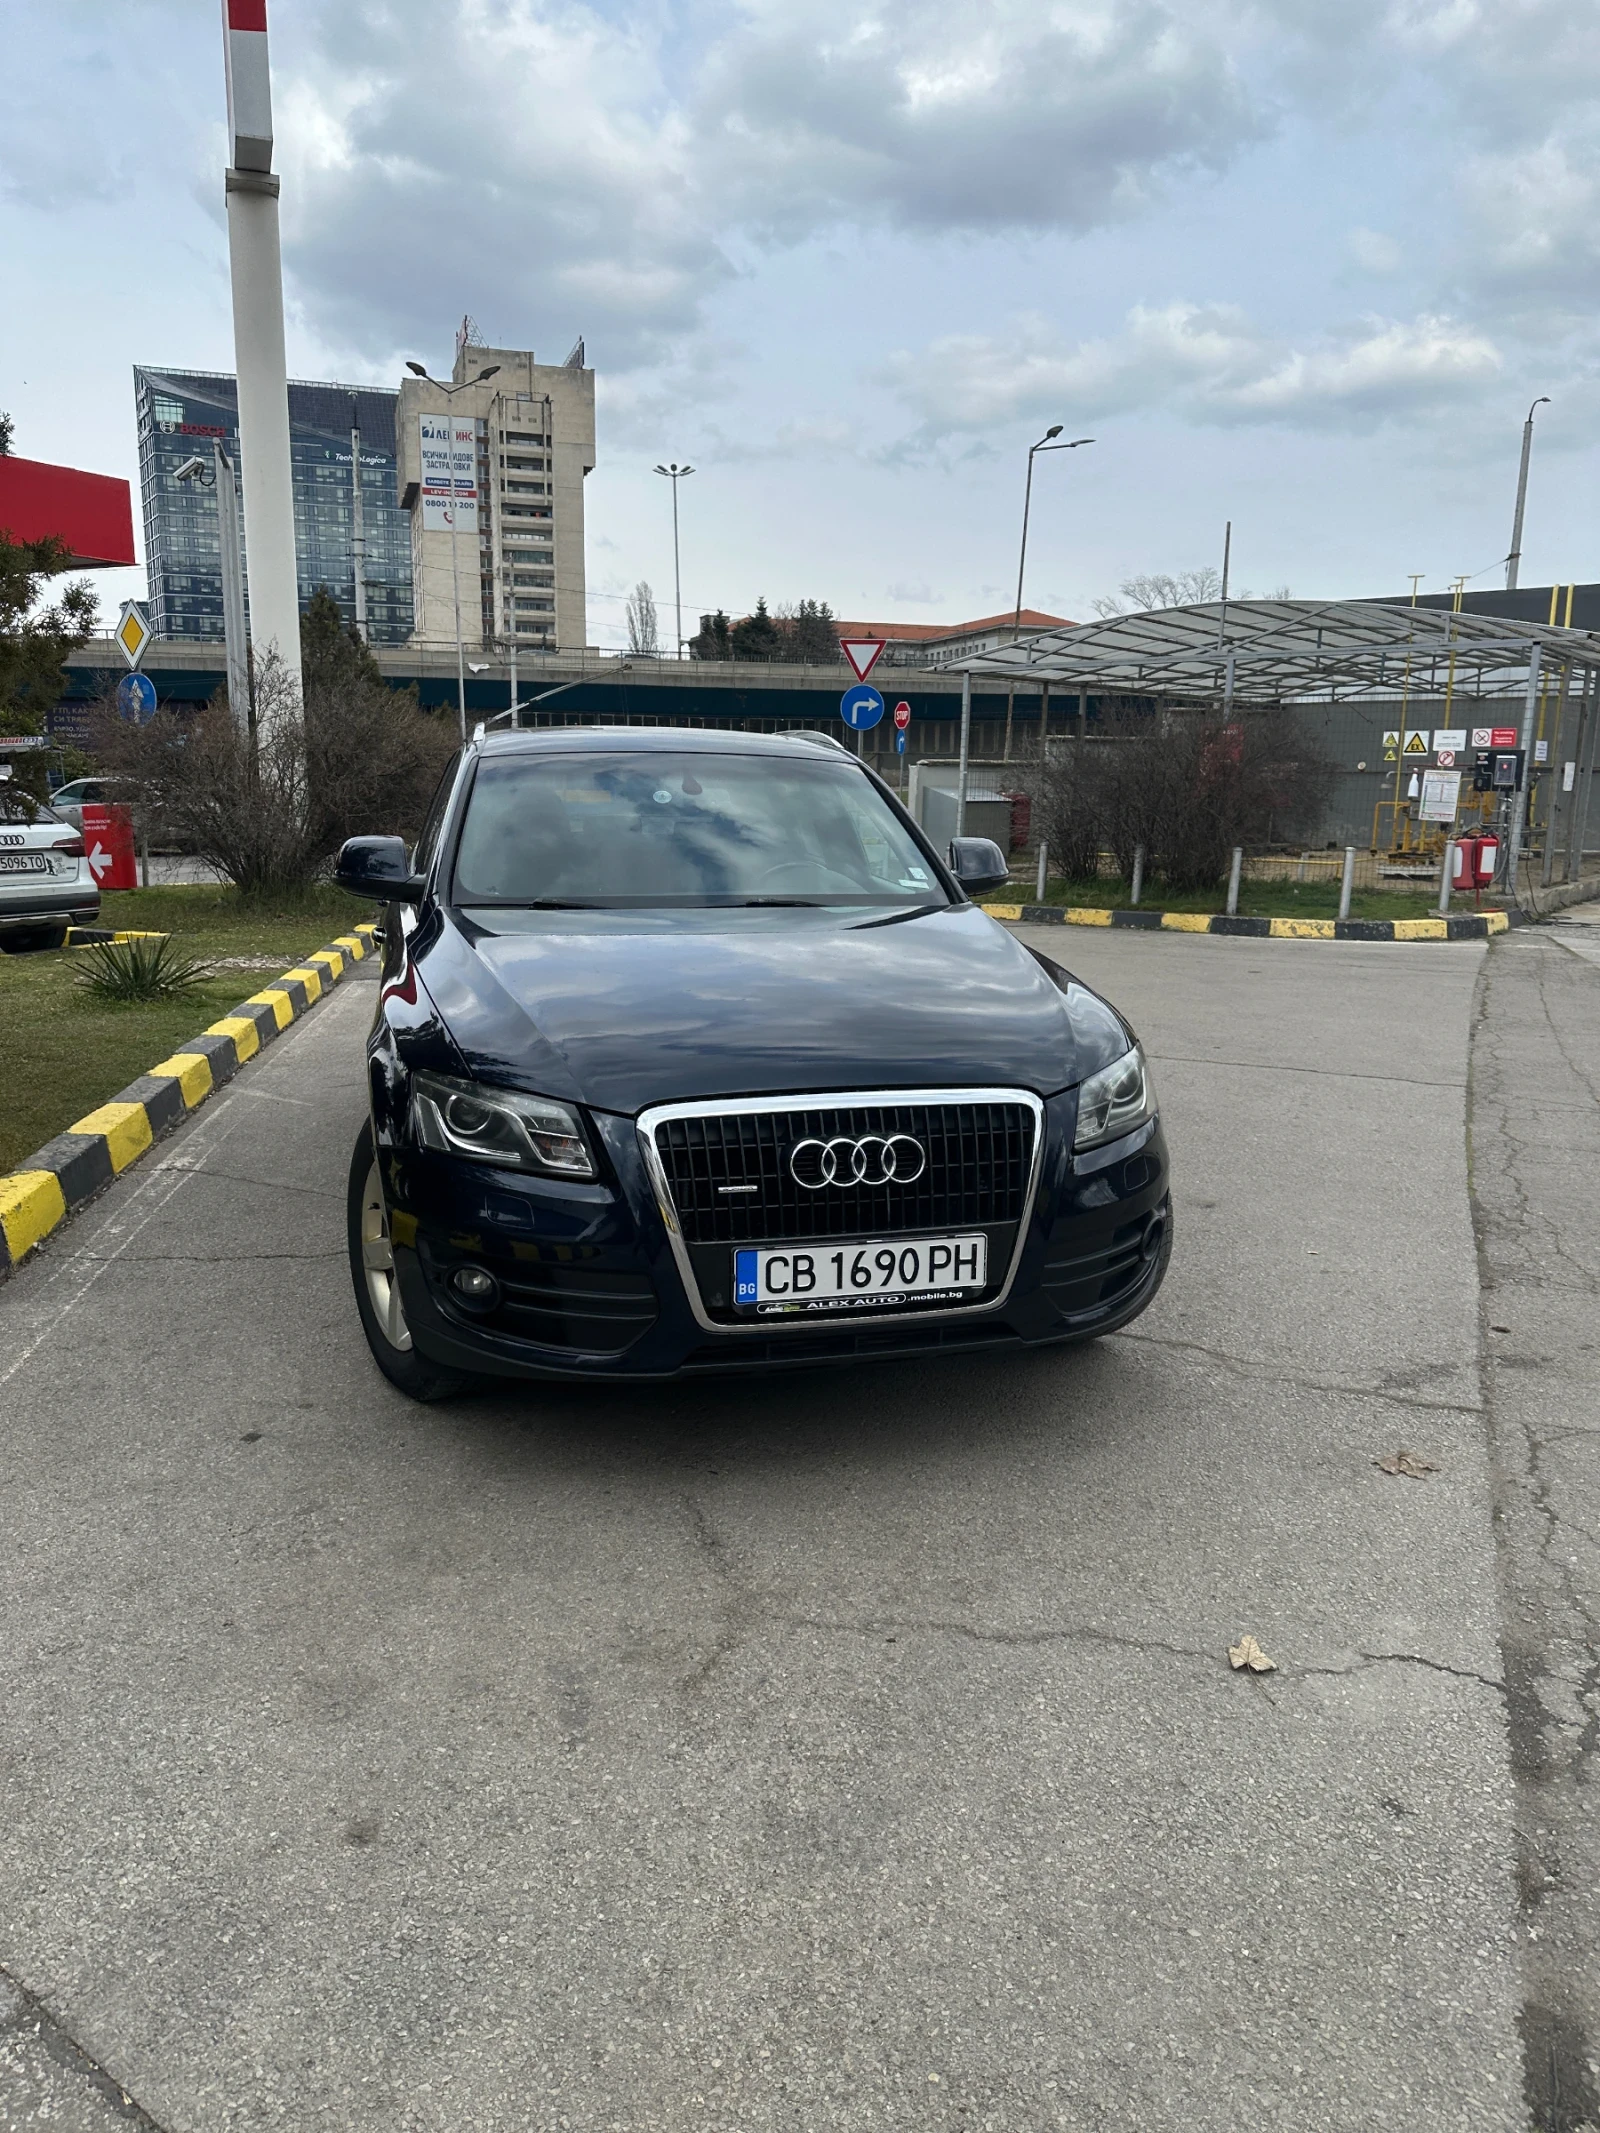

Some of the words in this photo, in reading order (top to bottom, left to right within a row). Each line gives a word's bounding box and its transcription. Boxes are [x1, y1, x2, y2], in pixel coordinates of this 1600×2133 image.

[181, 424, 226, 437] BOSCH
[456, 432, 473, 442] ИНС
[422, 450, 448, 460] ВСИЧКИ
[449, 452, 474, 462] ИДОВЕ
[426, 460, 470, 470] ЗАСТРАОВКИ
[896, 711, 908, 720] STOP
[1411, 743, 1420, 751] EX
[0, 857, 27, 868] 5096
[28, 856, 43, 868] TO
[765, 1254, 816, 1294] CB
[830, 1247, 920, 1290] 1690
[928, 1243, 978, 1283] PH
[739, 1283, 756, 1296] BG
[806, 1299, 850, 1309] ALEX
[853, 1295, 899, 1306] AUTO
[907, 1290, 963, 1301] .mobile.bg
